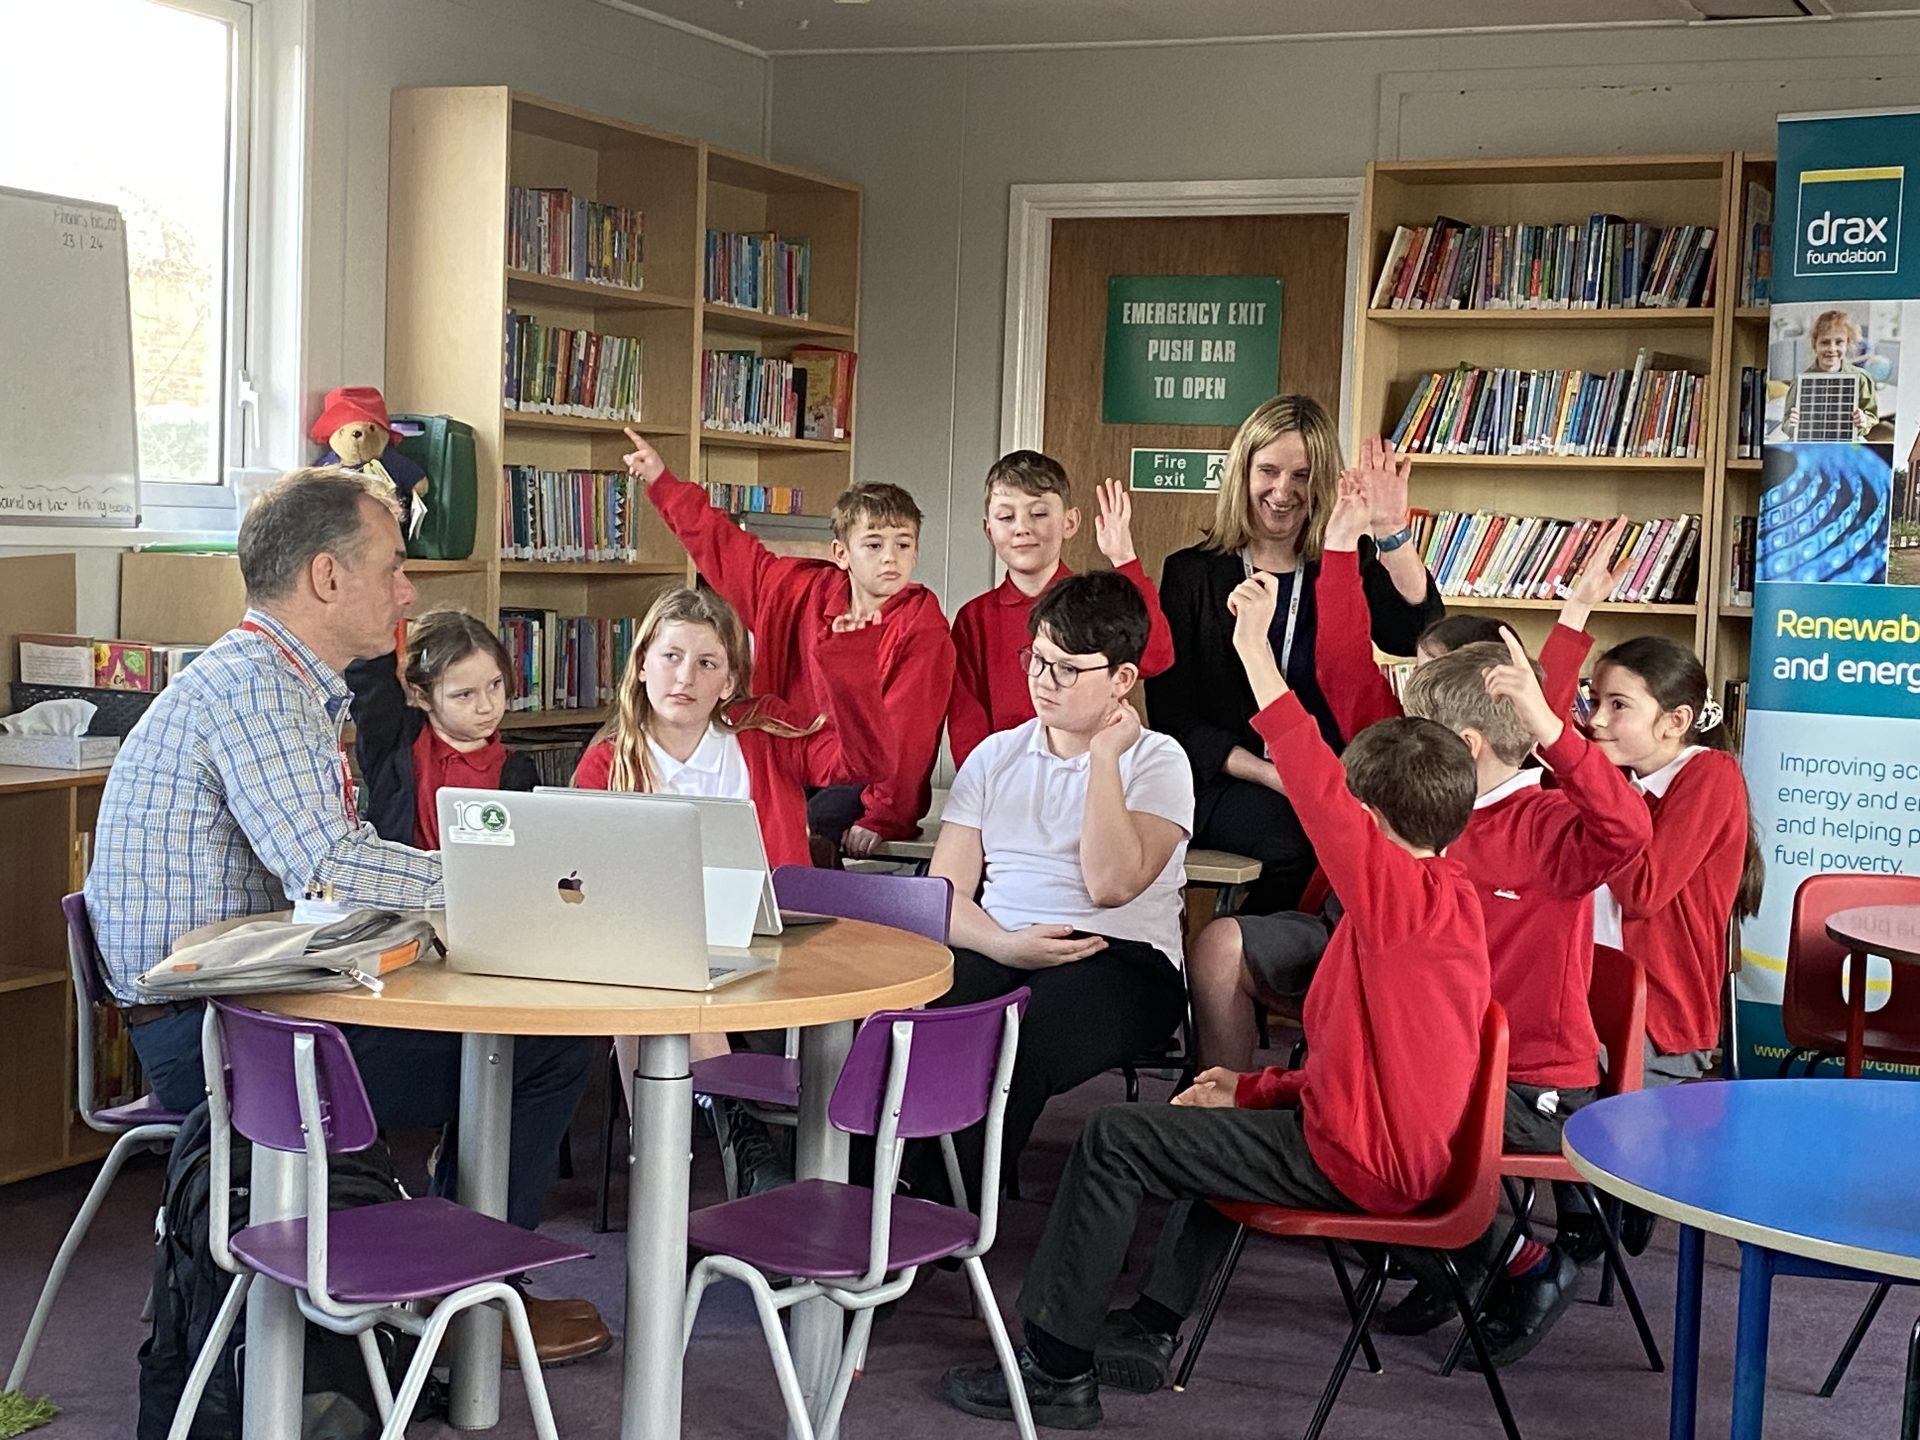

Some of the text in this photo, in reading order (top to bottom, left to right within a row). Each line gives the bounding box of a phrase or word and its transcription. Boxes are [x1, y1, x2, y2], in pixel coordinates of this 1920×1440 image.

[1807, 210, 1888, 246] drax
[1806, 248, 1886, 264] foundation
[1122, 302, 1267, 325] EMERGENCY EXIT
[1147, 339, 1236, 362] PUSH BAR
[1154, 376, 1226, 399] TO OPEN
[1154, 454, 1187, 469] Fire
[1154, 472, 1185, 487] exit
[1773, 652, 1829, 681] and
[1780, 752, 1886, 782] Improving
[1778, 787, 1852, 811] energy
[1857, 791, 1898, 810] and
[1776, 816, 1815, 835] and
[1822, 817, 1901, 847] helping
[1775, 844, 1903, 875] fuel poverty.
